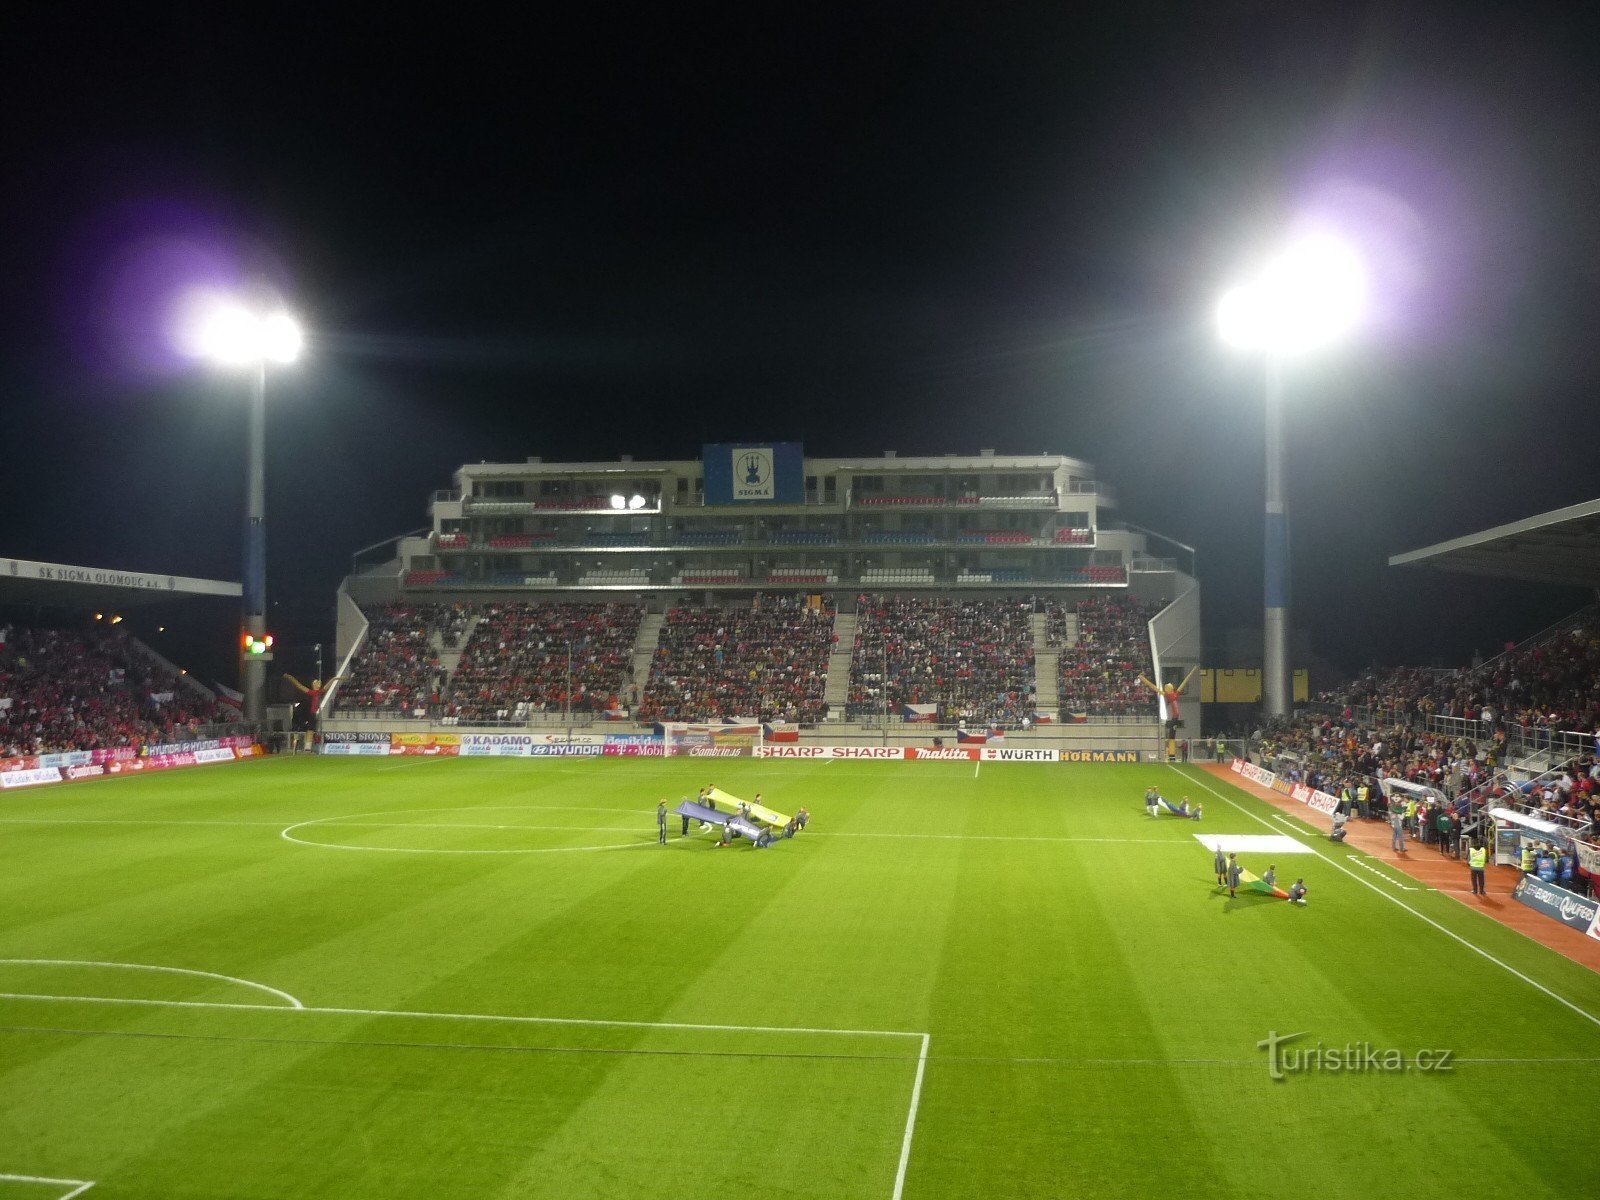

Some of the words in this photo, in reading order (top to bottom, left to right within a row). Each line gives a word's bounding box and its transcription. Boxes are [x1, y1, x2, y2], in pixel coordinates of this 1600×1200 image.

[40, 567, 54, 579] SK
[58, 569, 92, 582] SIGMA
[95, 573, 145, 587] OLOMOUC
[324, 732, 357, 741] STONES
[359, 732, 391, 741] STONES
[473, 736, 532, 745] KADAMO
[149, 743, 181, 756] HYUNDAI
[549, 745, 604, 755] HYUNDAI
[757, 747, 824, 757] SHARP
[832, 747, 900, 757] SHARP
[1000, 749, 1053, 760] WÜRTH
[1060, 751, 1137, 762] HÖRMANN
